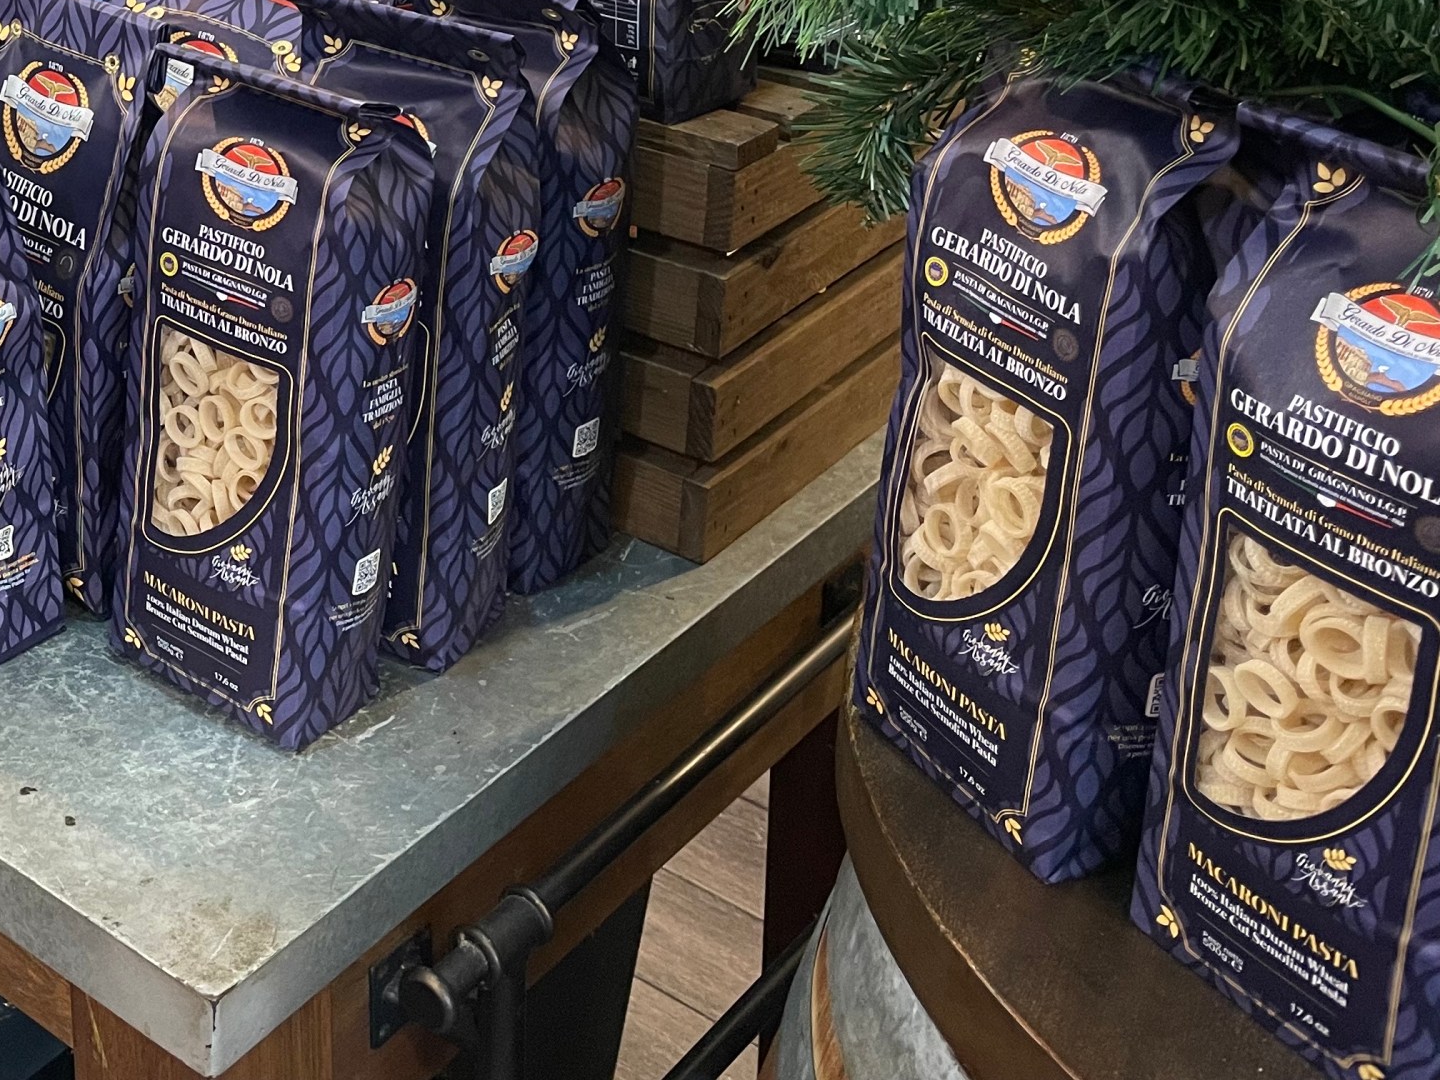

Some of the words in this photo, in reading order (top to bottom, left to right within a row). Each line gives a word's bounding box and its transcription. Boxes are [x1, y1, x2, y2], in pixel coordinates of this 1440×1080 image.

[17, 203, 37, 227] DI
[39, 214, 86, 250] NOLA
[198, 224, 266, 259] PASTIFICIO
[980, 228, 1048, 279] PASTIFICIO
[162, 227, 233, 270] GERARDO
[234, 254, 254, 277] DI
[254, 264, 294, 292] NOLA
[931, 226, 1012, 282] GERARDO
[1010, 271, 1032, 297] DI
[1034, 277, 1082, 325] NOLA
[160, 292, 216, 327] TRAFILATA
[218, 316, 233, 334] AL
[234, 323, 288, 354] BRONZO
[923, 304, 985, 357] TRAFILATA
[986, 341, 1005, 368] AL
[1006, 357, 1067, 401] BRONZO
[1339, 302, 1387, 345] Gerardo
[1389, 330, 1414, 352] Di
[1286, 393, 1401, 458] PASTIFICIO
[1225, 475, 1316, 545] TRAFILATA
[1317, 530, 1345, 557] AL
[1346, 543, 1440, 600] BRONZO
[143, 571, 210, 621] MACARONI
[212, 609, 255, 641] PASTA
[887, 627, 956, 702] MACARONI
[959, 691, 1006, 741] PASTA
[1188, 842, 1289, 932] MACARONI
[1292, 923, 1358, 980] PASTA
